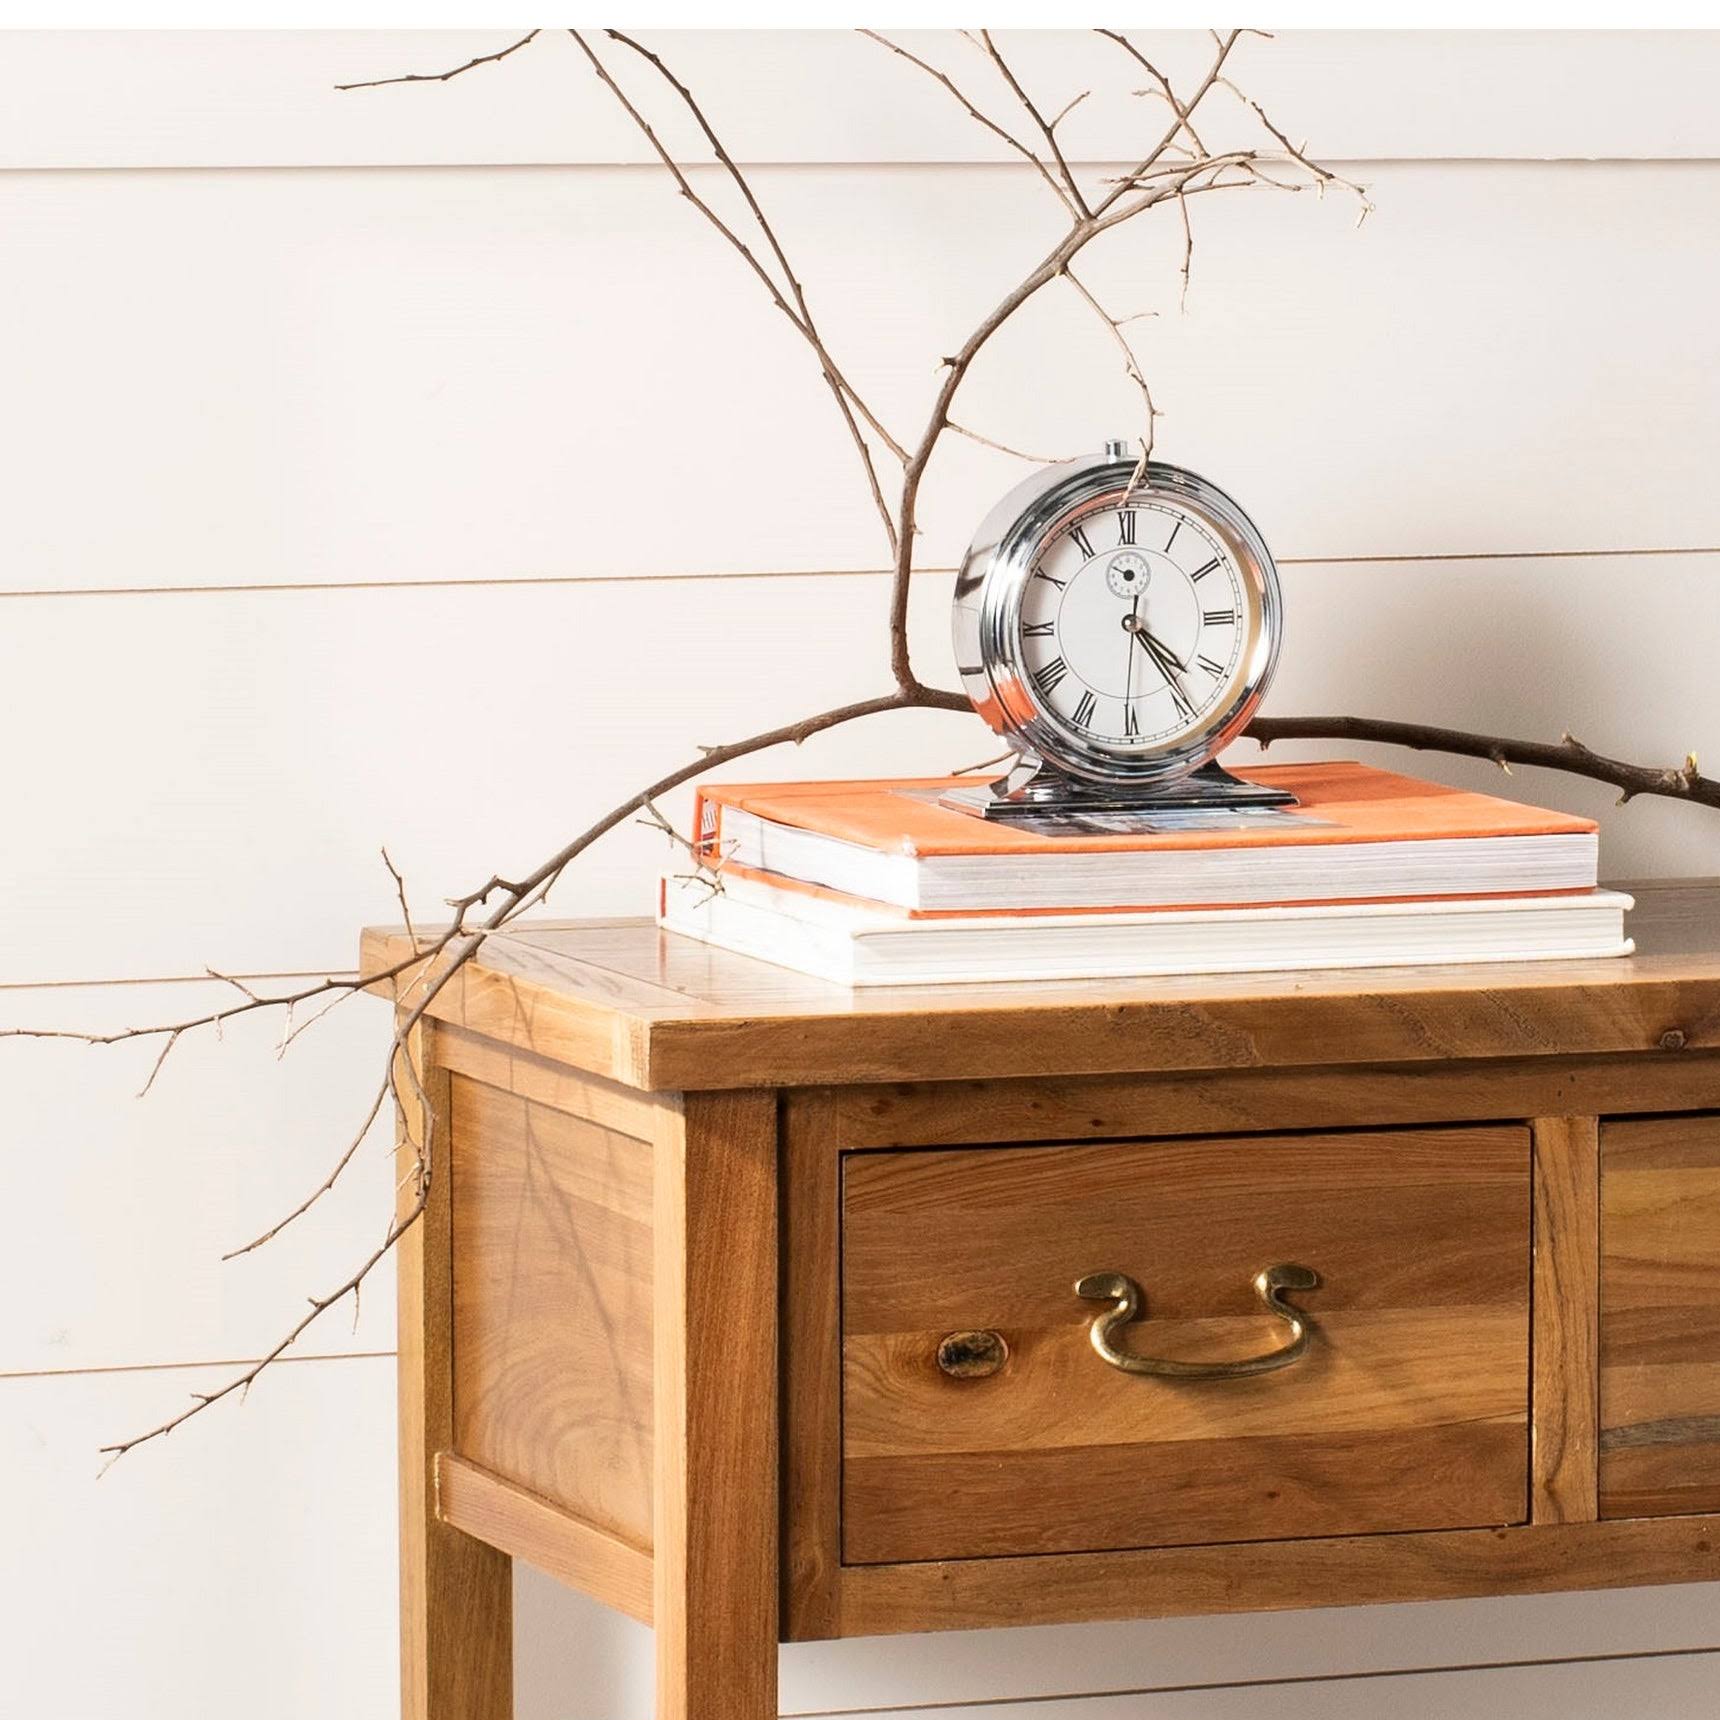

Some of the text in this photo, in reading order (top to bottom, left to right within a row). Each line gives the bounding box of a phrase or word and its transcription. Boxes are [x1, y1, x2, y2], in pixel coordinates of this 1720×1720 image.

[1068, 525, 1096, 562] XI
[1117, 510, 1137, 546] XII
[1164, 522, 1182, 553] I
[1033, 565, 1067, 592] X
[1190, 557, 1221, 583] II
[1022, 620, 1055, 638] IX
[1203, 608, 1235, 627] III
[1032, 655, 1068, 698] VIII
[1197, 653, 1225, 682] IV
[1071, 690, 1097, 729] VII
[1124, 703, 1140, 736] VI
